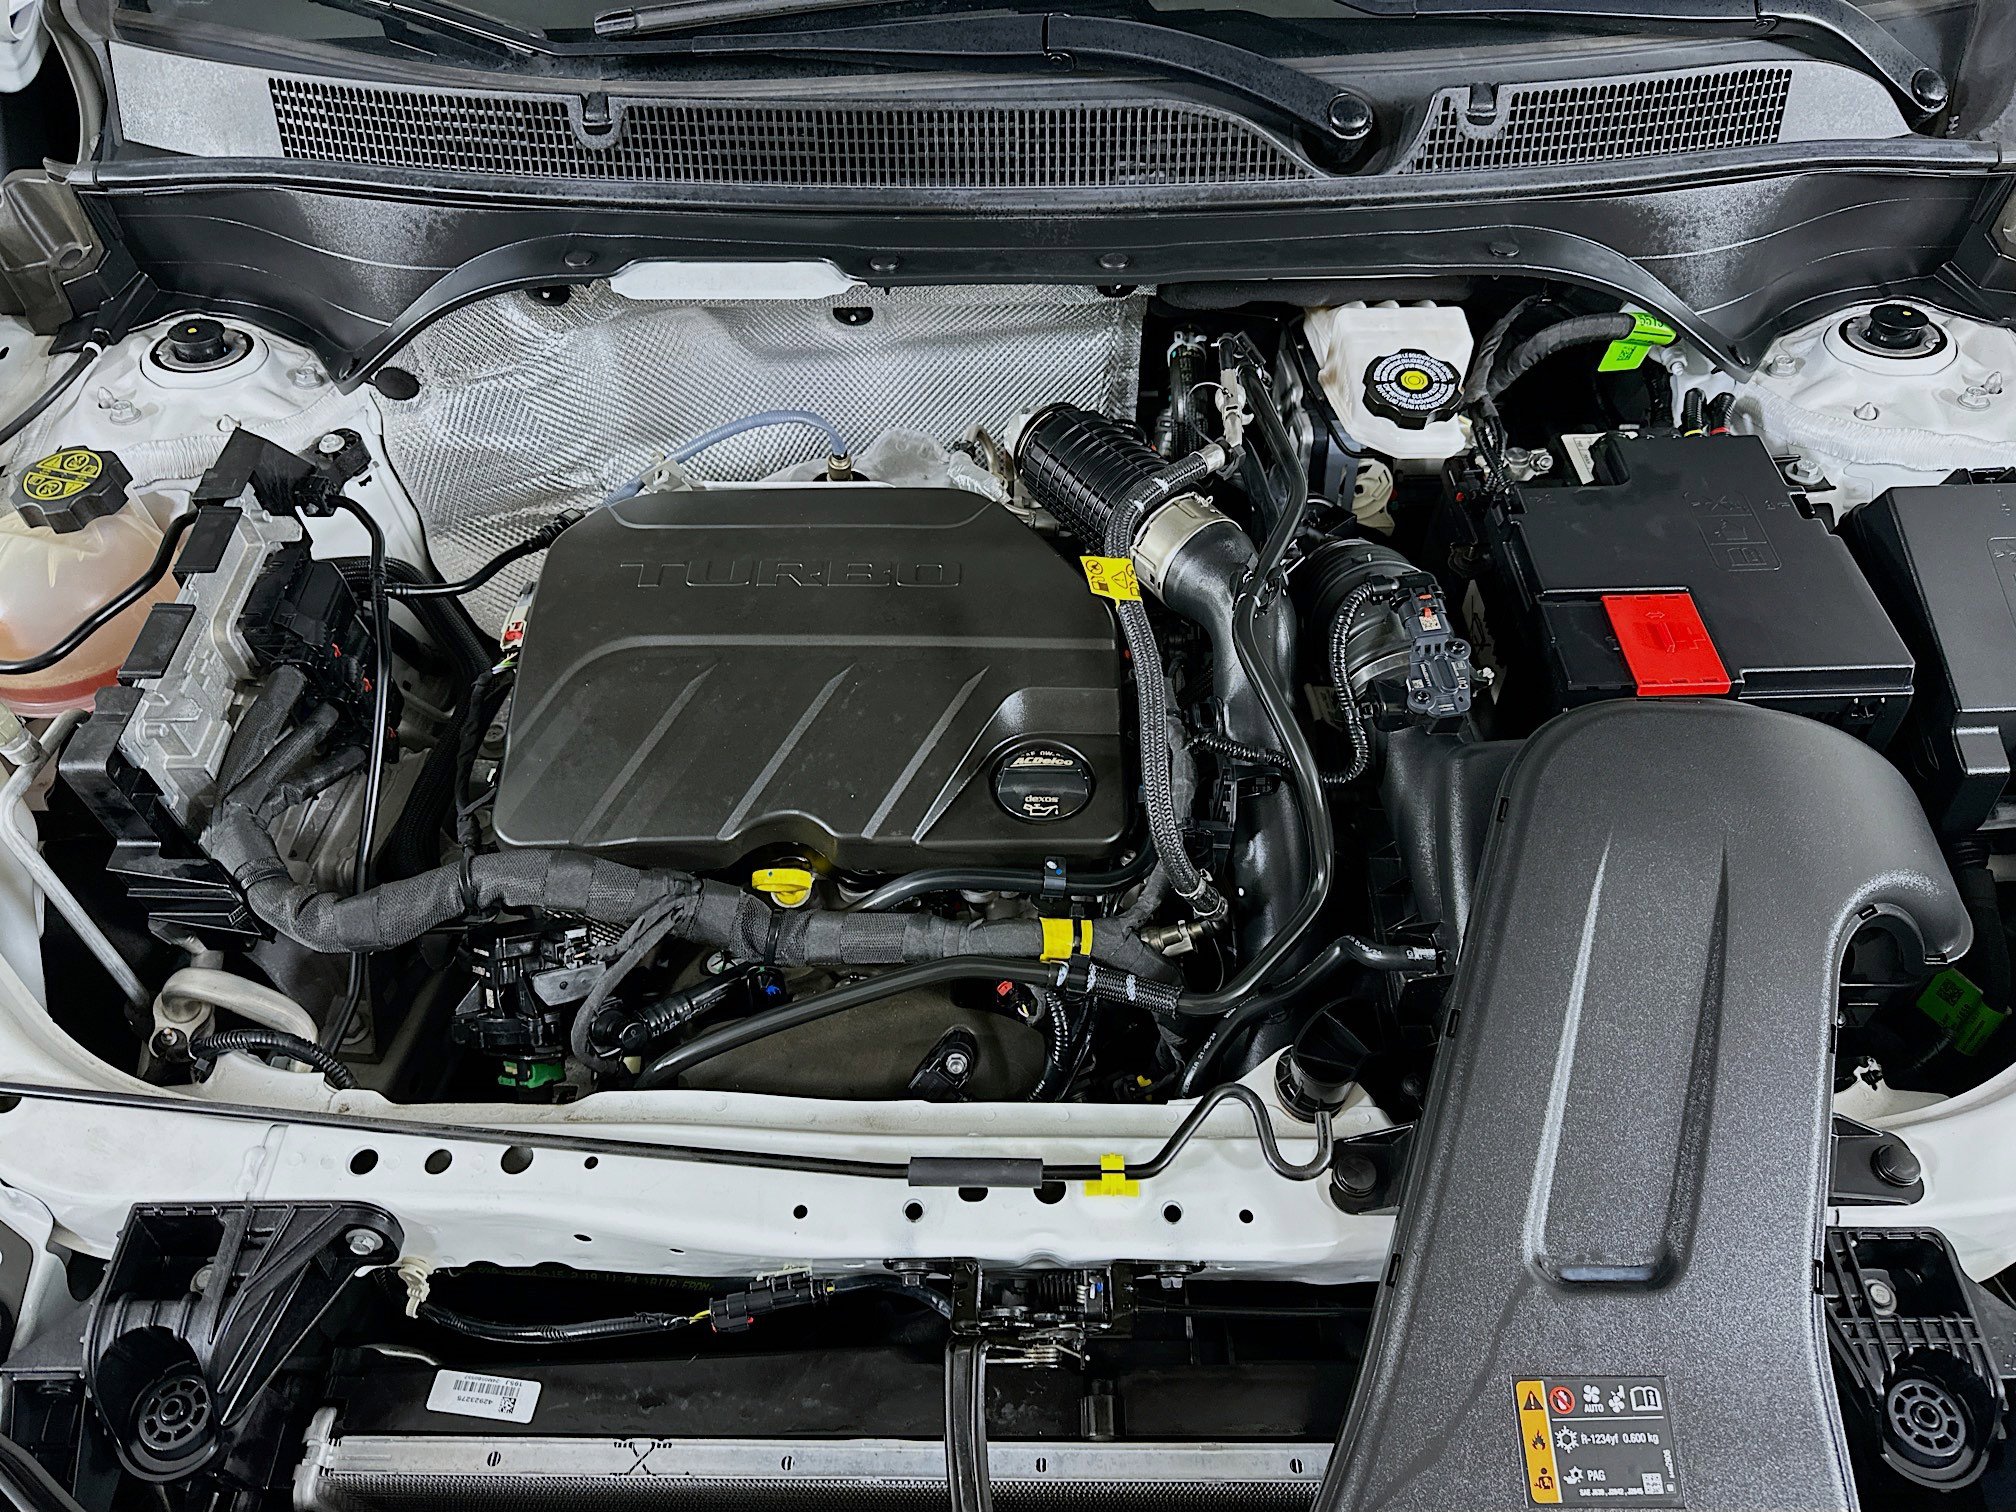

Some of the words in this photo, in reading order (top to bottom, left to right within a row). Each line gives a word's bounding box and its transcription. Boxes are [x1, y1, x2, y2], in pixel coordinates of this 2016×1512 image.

[620, 560, 963, 588] TURBO
[1010, 757, 1074, 768] ACDelco
[1025, 795, 1059, 803] dexos
[457, 1395, 493, 1405] 42923275
[1584, 1403, 1604, 1413] AUTO
[1581, 1433, 1618, 1445] R-1234yf
[1622, 1433, 1646, 1443] 0.600
[1648, 1433, 1660, 1445] kg
[1587, 1470, 1606, 1481] PAG
